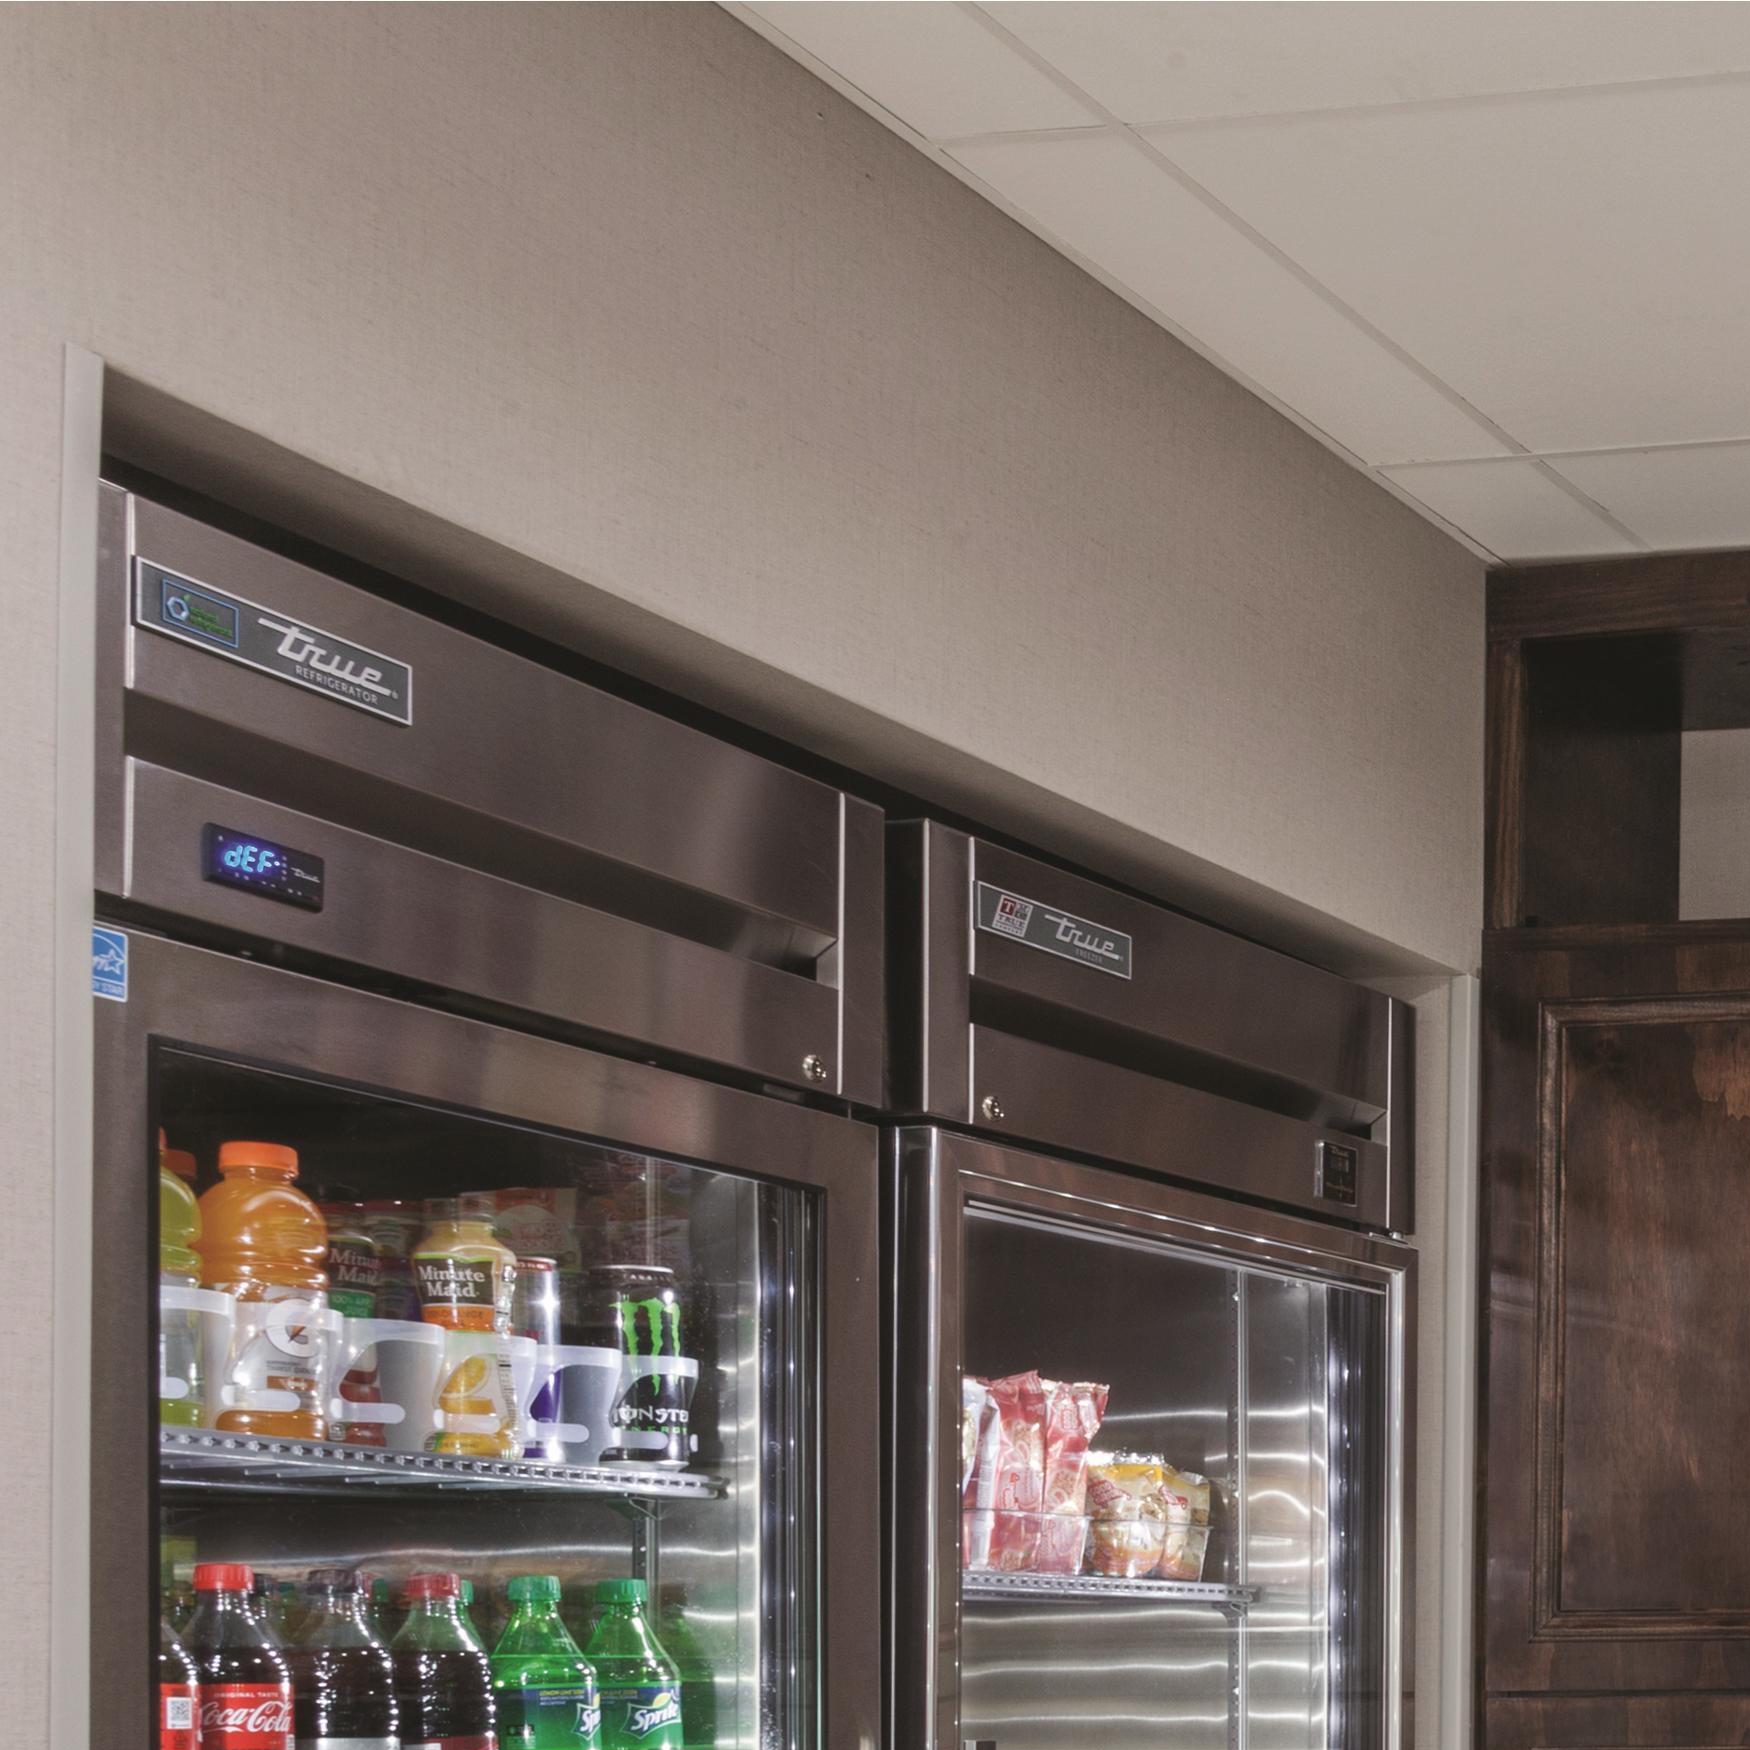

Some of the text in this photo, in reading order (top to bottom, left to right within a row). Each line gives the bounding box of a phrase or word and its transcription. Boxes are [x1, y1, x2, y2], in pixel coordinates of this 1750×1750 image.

[295, 664, 378, 705] REFRIGERATOR
[418, 1265, 486, 1284] Minute
[200, 1700, 292, 1733] Coca-Cola
[631, 1701, 681, 1732] Sprite
